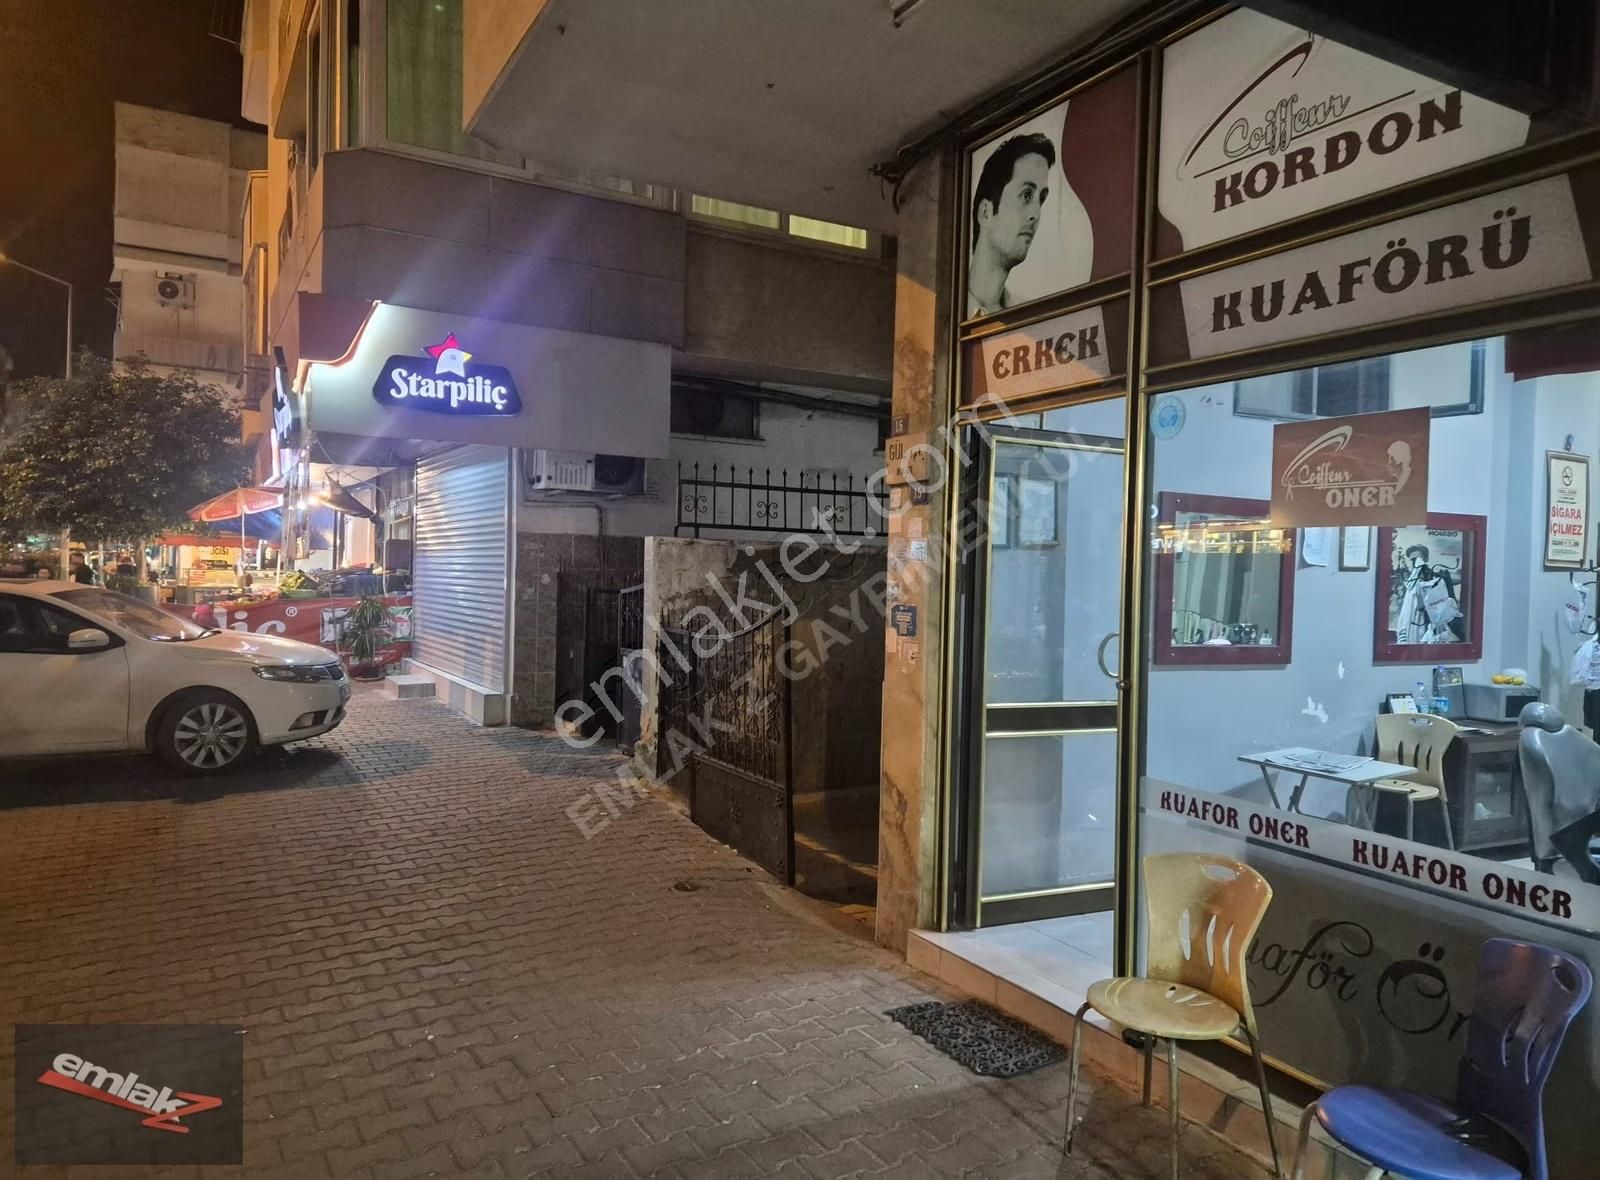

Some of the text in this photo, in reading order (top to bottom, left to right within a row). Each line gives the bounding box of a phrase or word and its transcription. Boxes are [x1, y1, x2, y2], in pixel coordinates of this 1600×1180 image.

[1223, 91, 1352, 156] Coiffeur
[1212, 90, 1464, 213] KORDON
[991, 206, 1533, 382] ERKEK KUAFÖRÜ
[389, 366, 508, 411] Starpiliç
[1297, 461, 1352, 487] Coiffeur
[1325, 485, 1396, 509] ONER
[1551, 505, 1582, 520] SİGARA
[1160, 790, 1573, 919] KUAFOR ONER KUAFOR ONER
